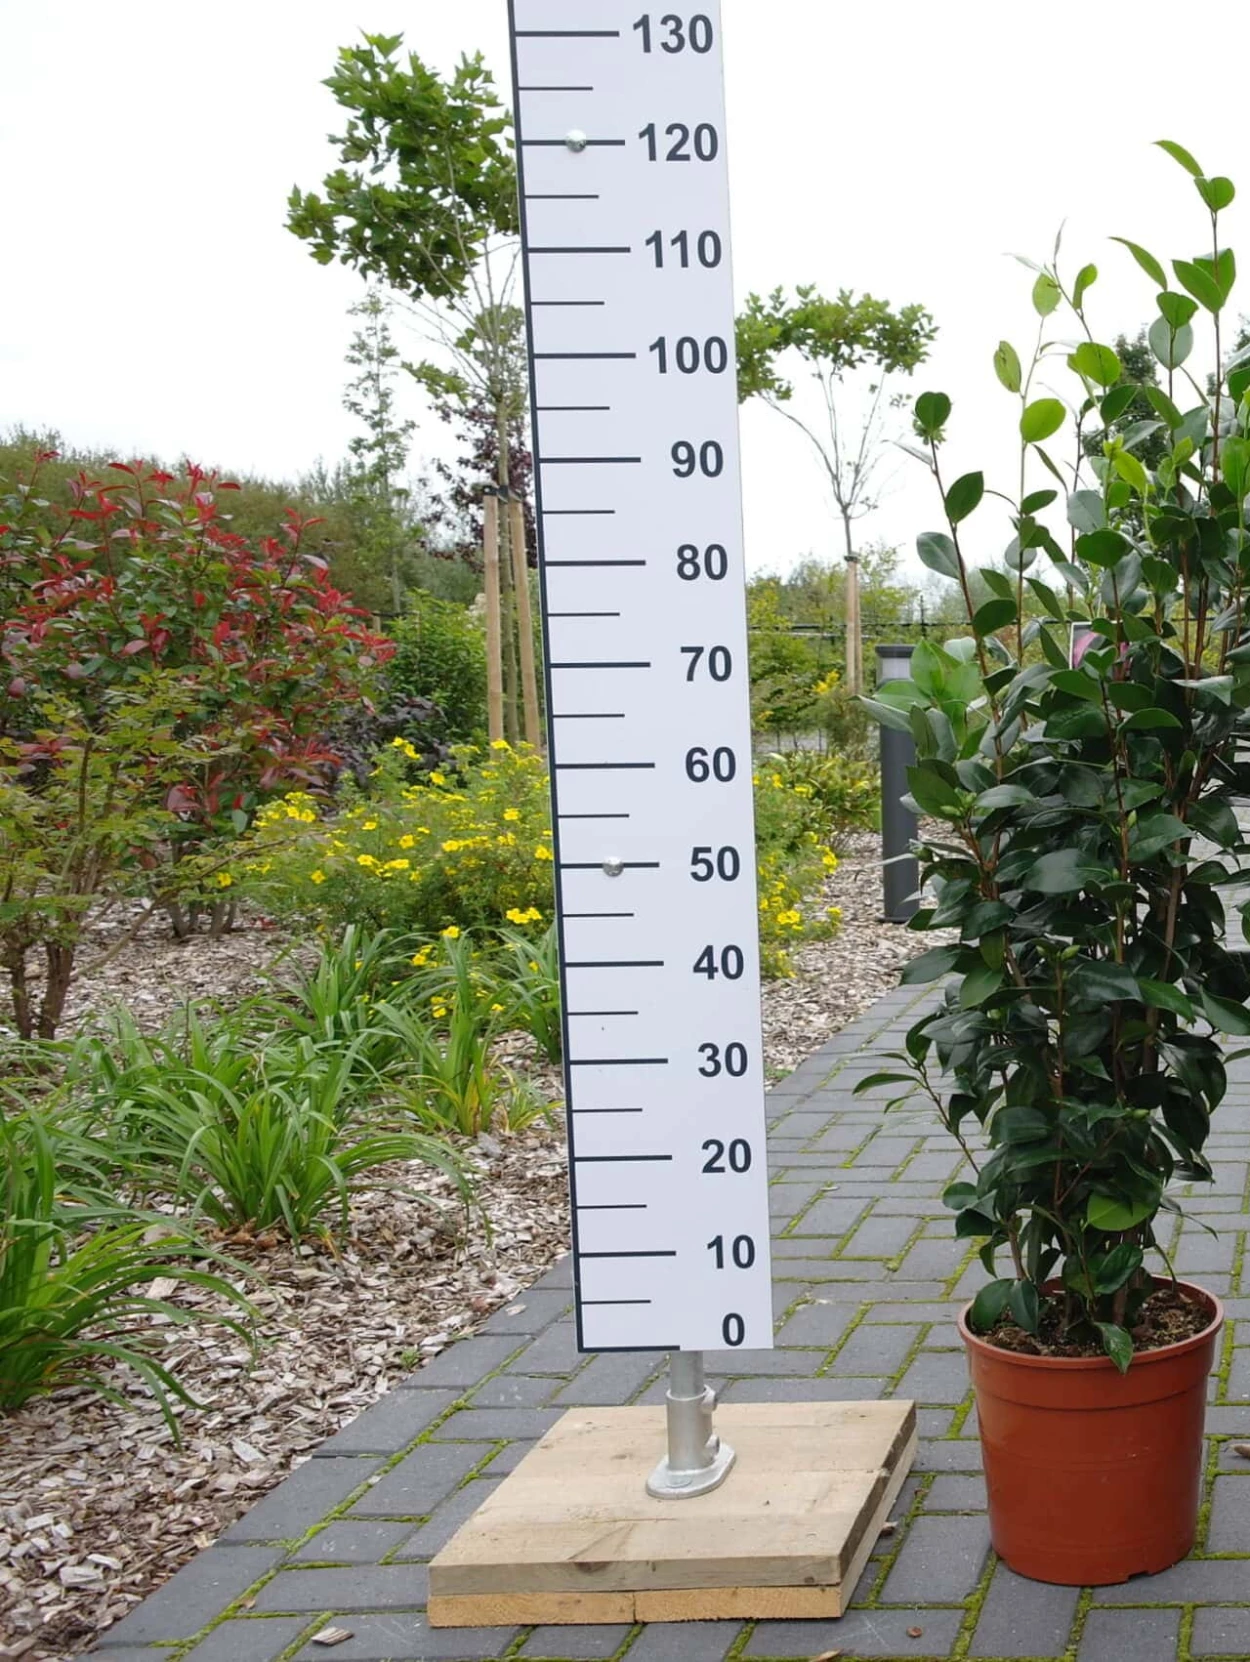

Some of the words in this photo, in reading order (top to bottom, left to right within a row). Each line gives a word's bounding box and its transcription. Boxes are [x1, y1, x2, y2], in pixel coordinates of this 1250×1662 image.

[633, 14, 713, 54] 130
[638, 123, 718, 162] 120
[645, 230, 722, 269] 110
[649, 336, 728, 374] 100
[671, 440, 724, 478] 90
[676, 543, 728, 581] 80
[680, 645, 732, 682] 70
[685, 746, 736, 783] 60
[690, 845, 740, 882] 50
[692, 944, 744, 980] 40
[697, 1041, 748, 1078] 30
[701, 1138, 752, 1174] 20
[707, 1234, 756, 1270] 10
[722, 1312, 745, 1347] 0
